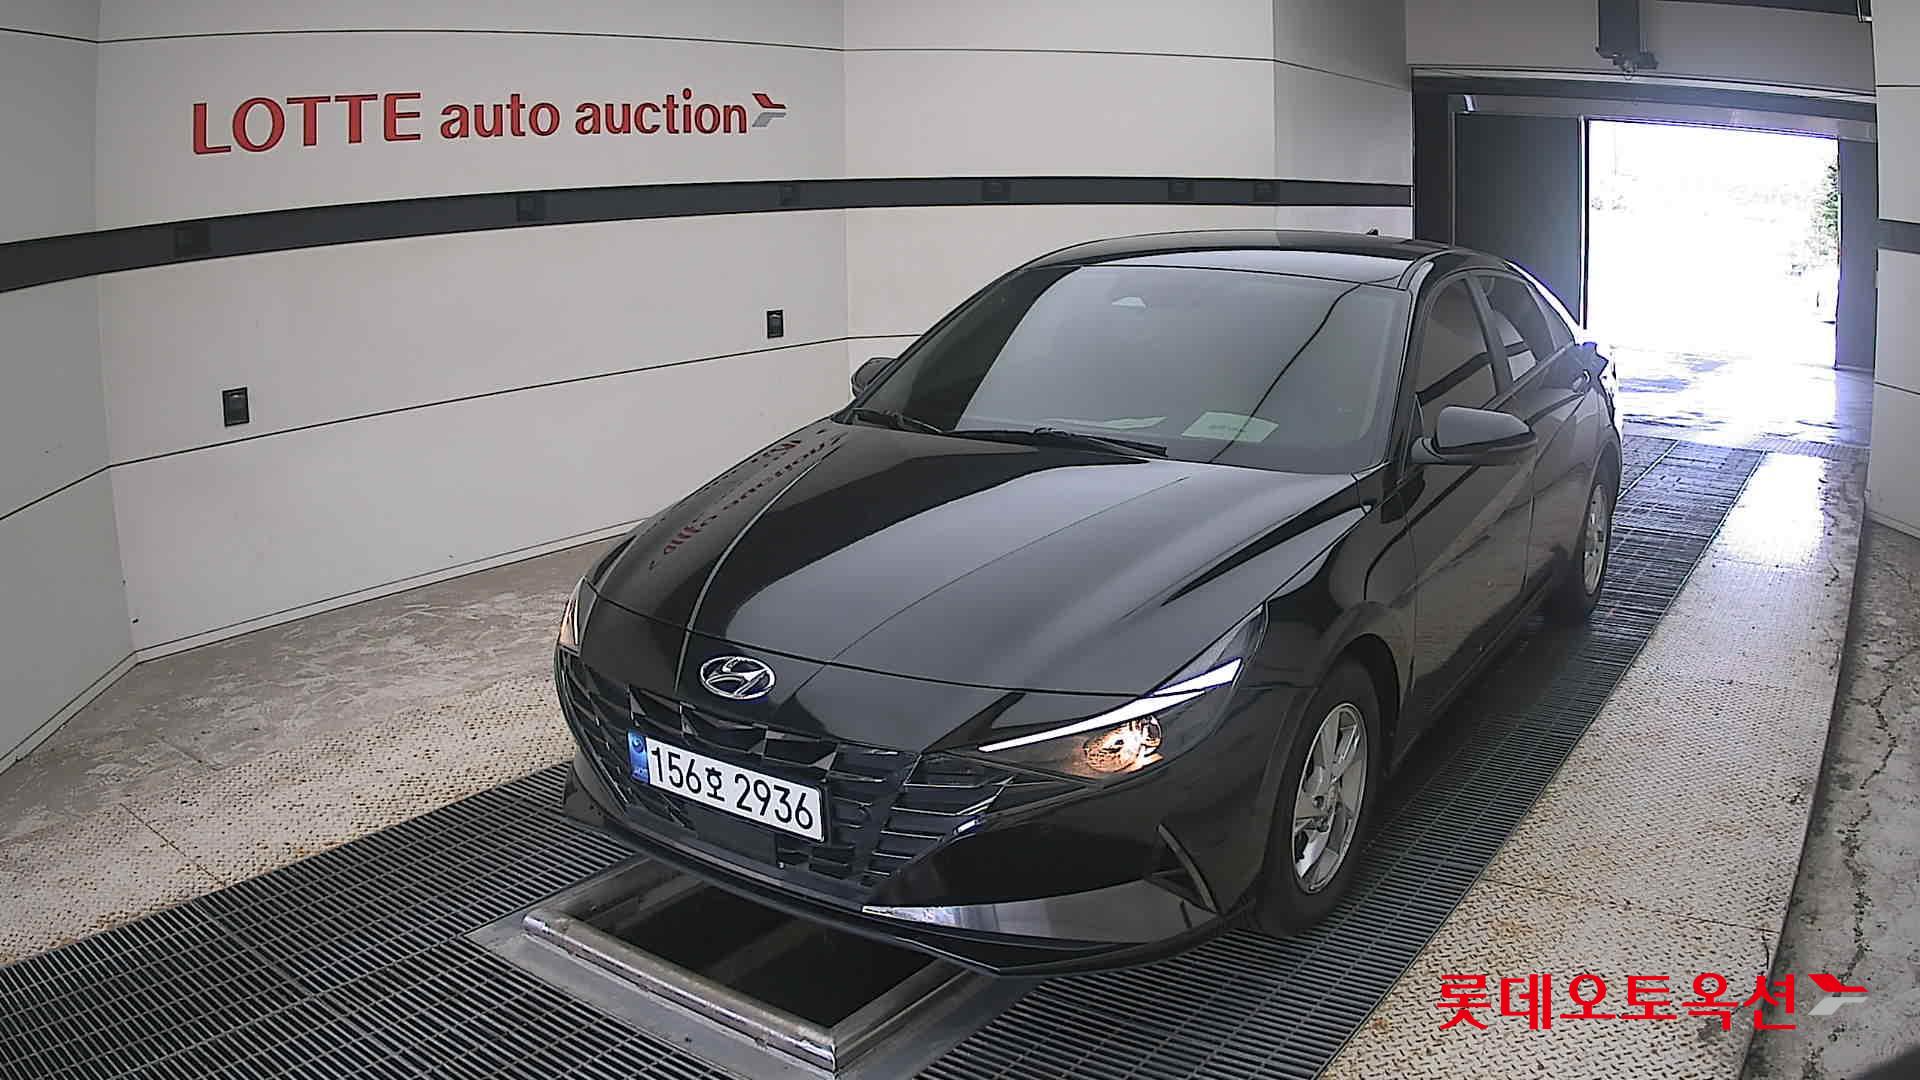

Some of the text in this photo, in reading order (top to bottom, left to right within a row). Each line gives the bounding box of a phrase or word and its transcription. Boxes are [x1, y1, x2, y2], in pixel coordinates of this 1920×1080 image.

[192, 88, 748, 154] LOTTE auto auction
[650, 747, 814, 830] 156호 2936
